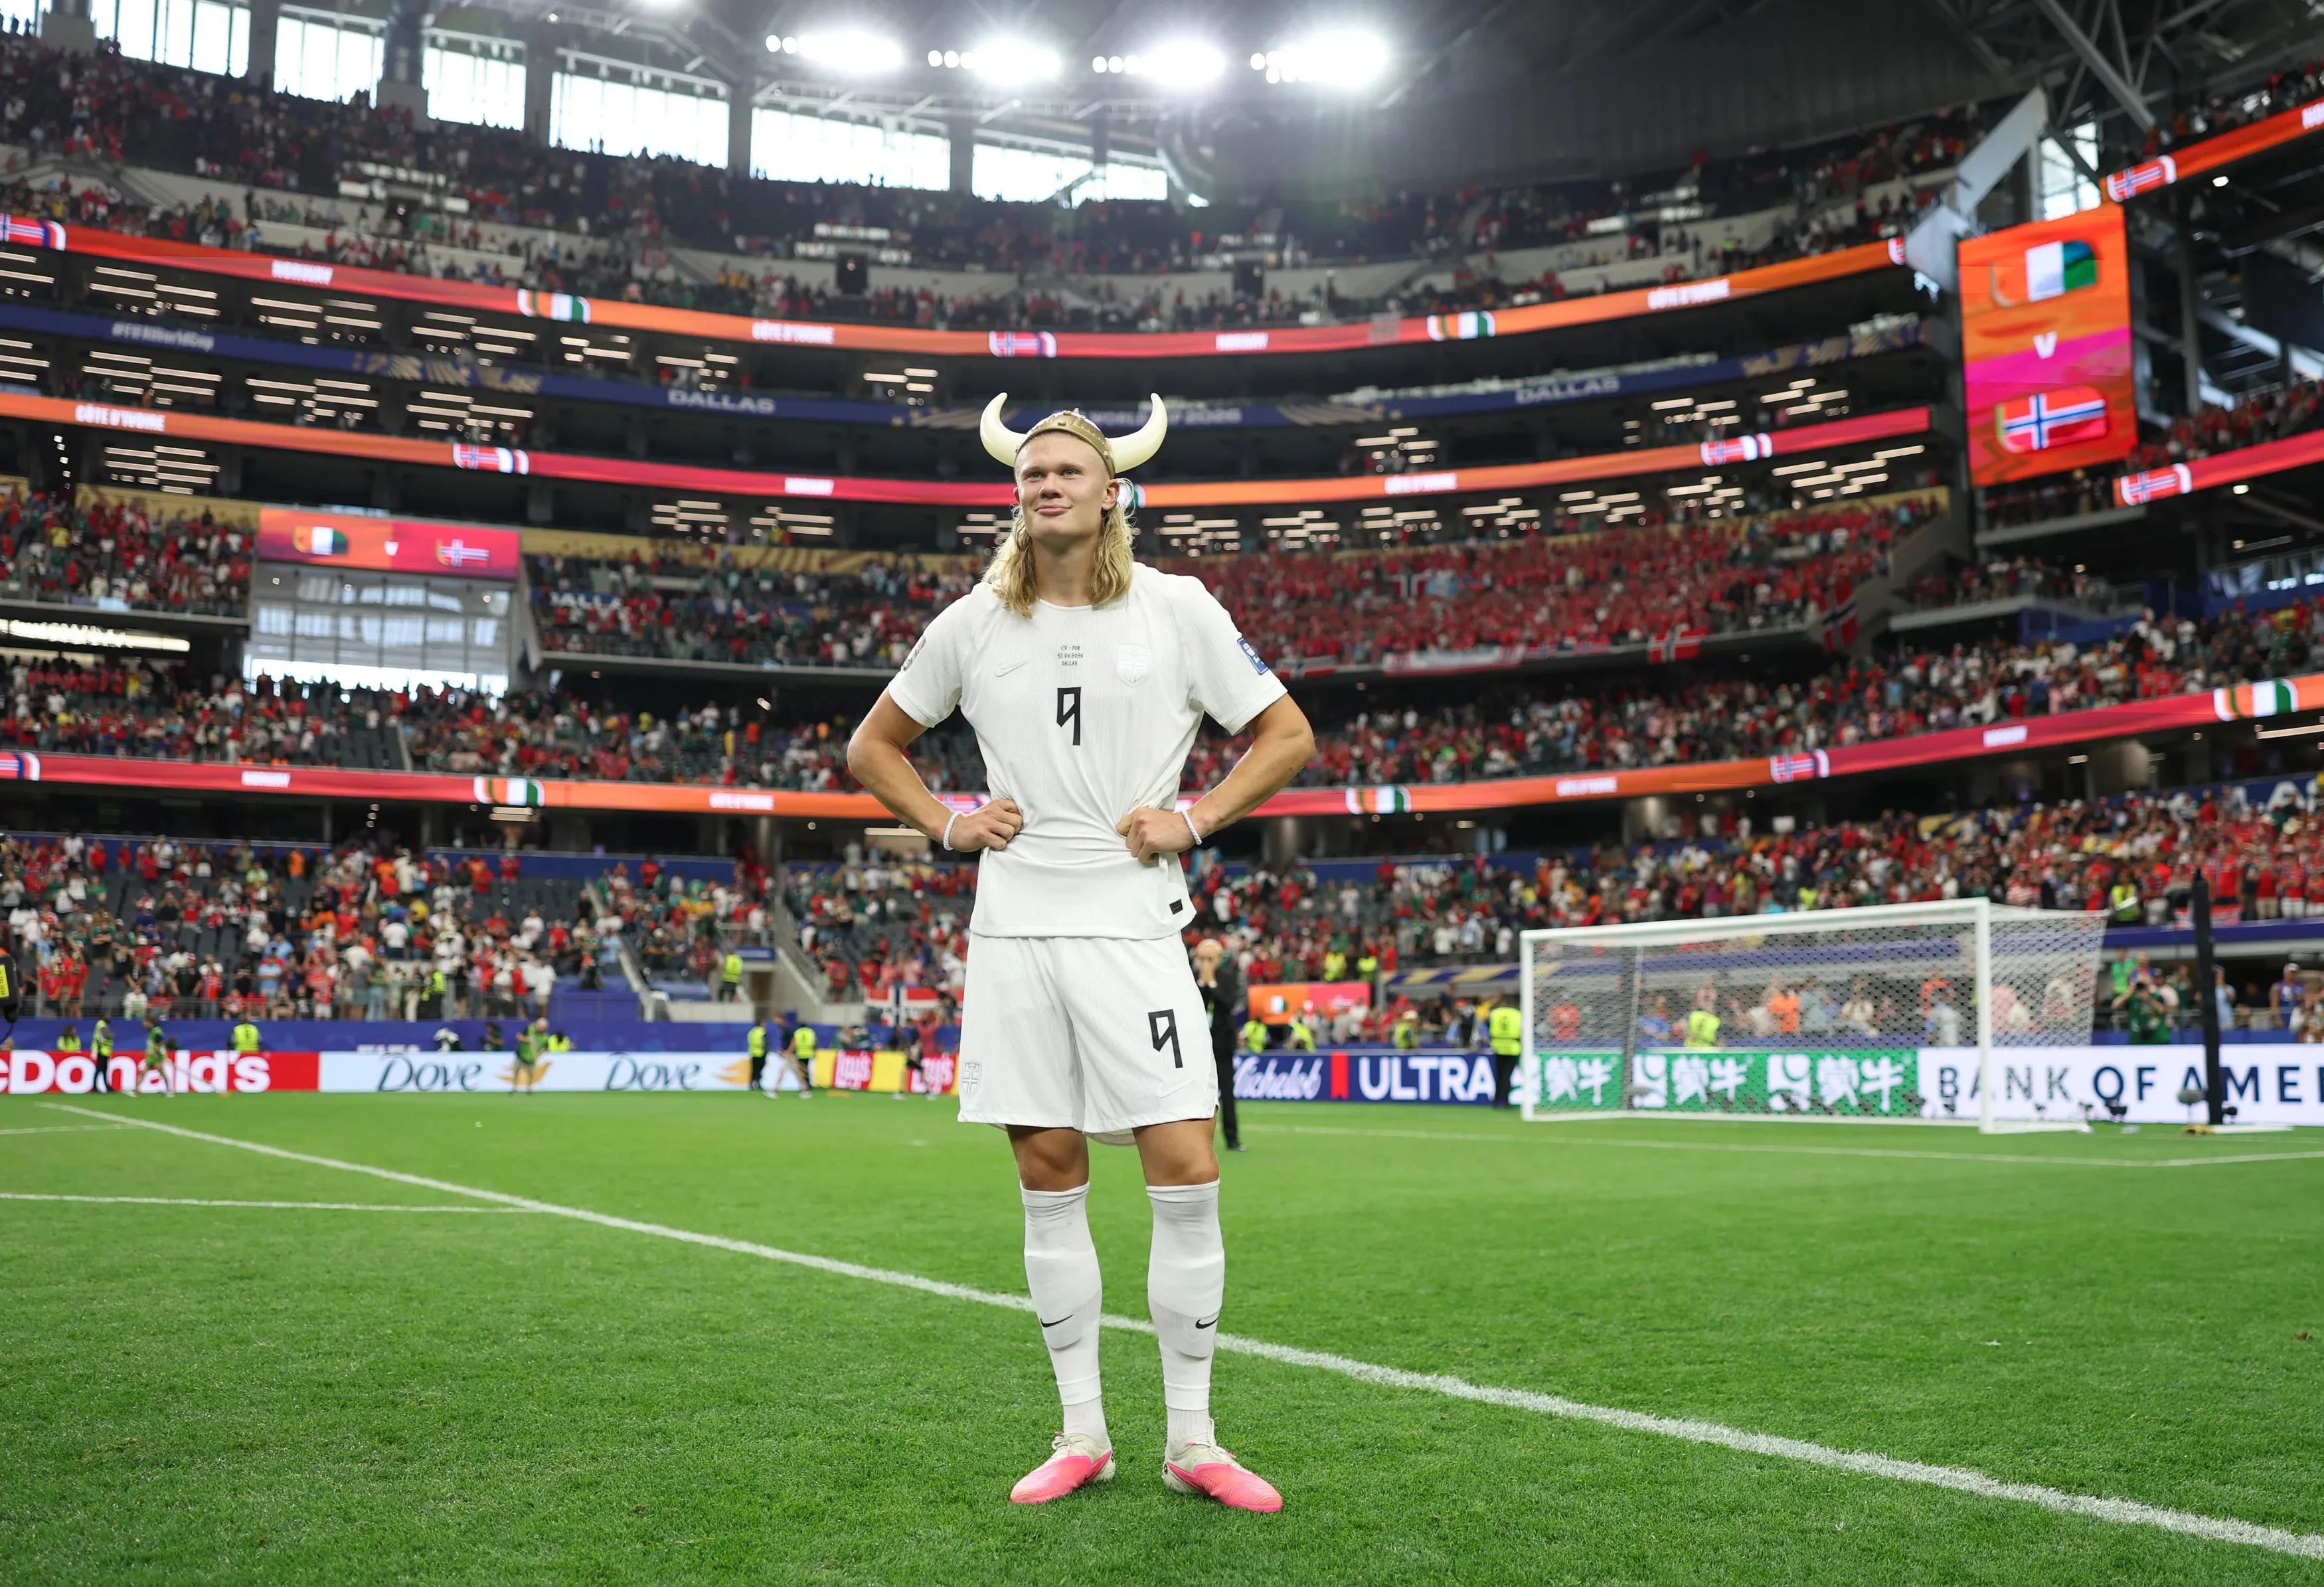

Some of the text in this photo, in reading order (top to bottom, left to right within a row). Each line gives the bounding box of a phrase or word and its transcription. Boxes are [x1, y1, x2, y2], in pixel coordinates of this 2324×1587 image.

[667, 388, 776, 414] DALLAS
[1056, 687, 1081, 746] 9
[1147, 1009, 1183, 1068] 9
[0, 1050, 271, 1094] Donald's
[377, 1052, 482, 1092] Dove
[604, 1051, 701, 1091] Dove
[1359, 1056, 1497, 1101] ULTRA
[2094, 1066, 2156, 1100] OF
